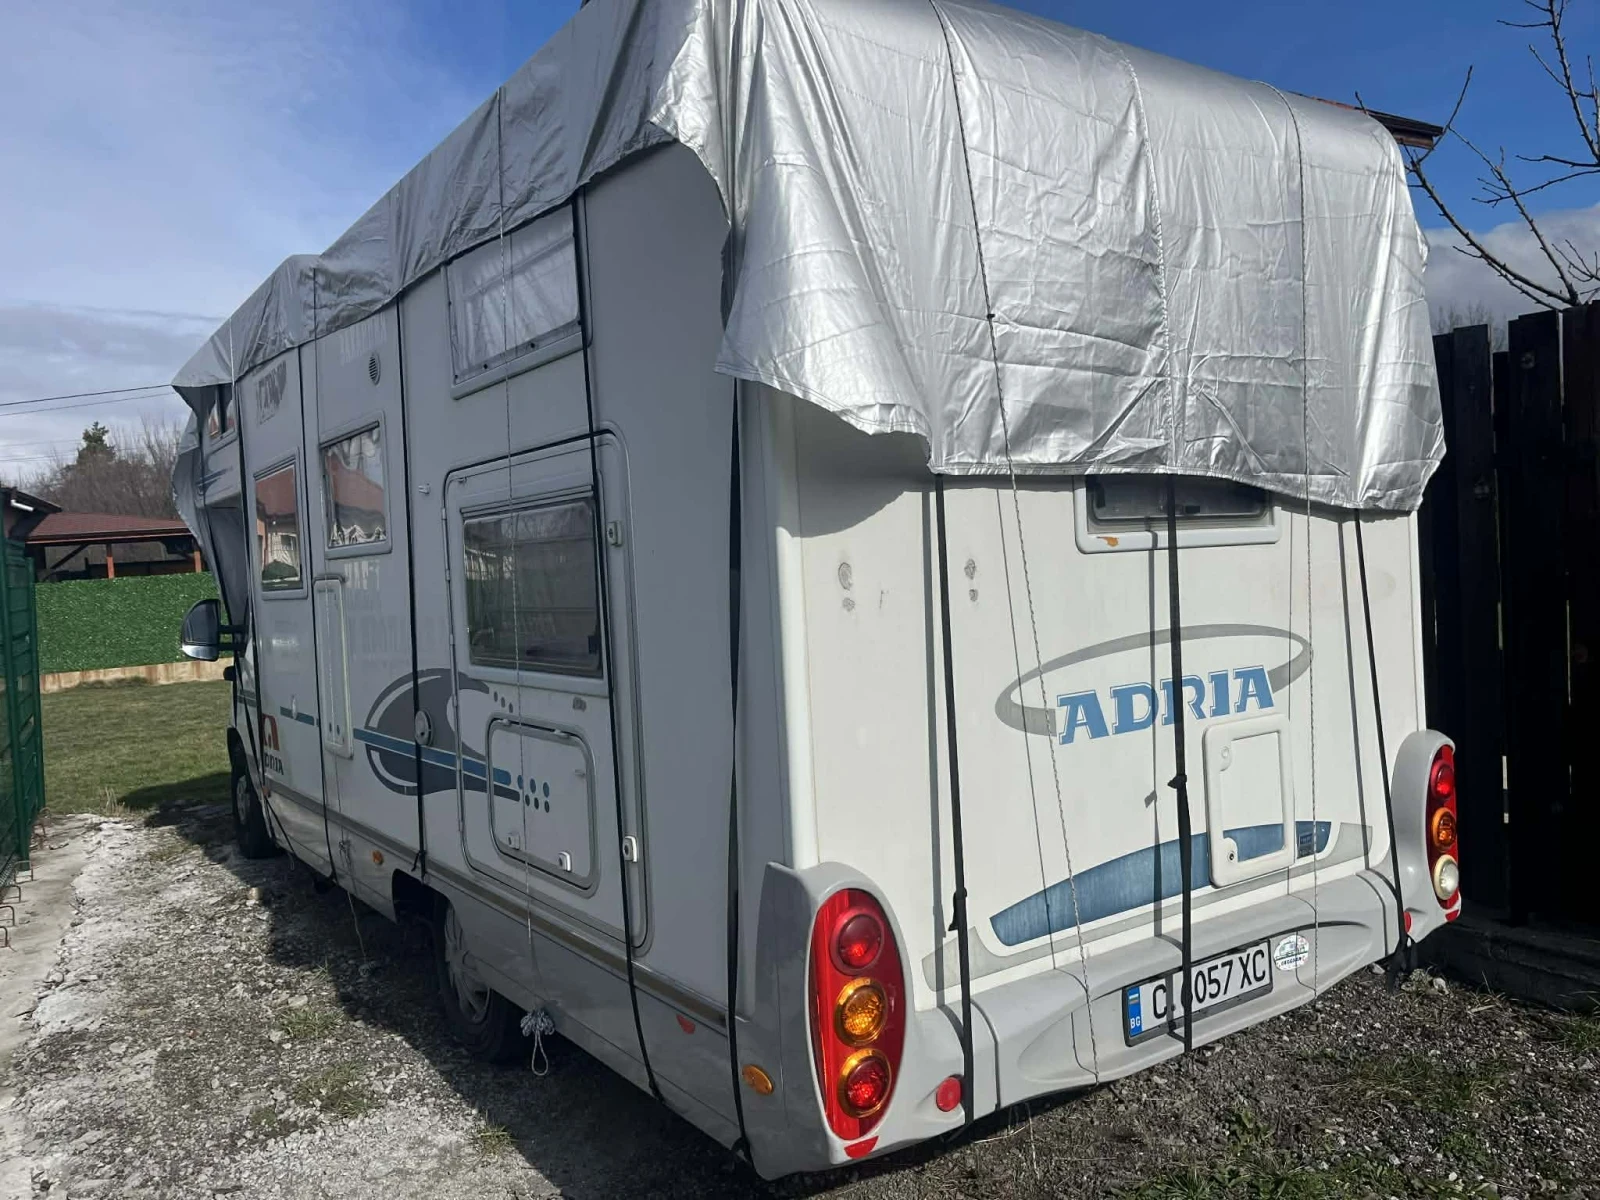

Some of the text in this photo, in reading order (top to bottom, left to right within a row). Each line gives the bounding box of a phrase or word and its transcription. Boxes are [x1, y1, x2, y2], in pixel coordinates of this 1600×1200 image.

[1056, 665, 1274, 745] ADRIA
[1152, 983, 1168, 1019] C
[1239, 949, 1267, 989] XC
[1130, 1016, 1141, 1030] BG
